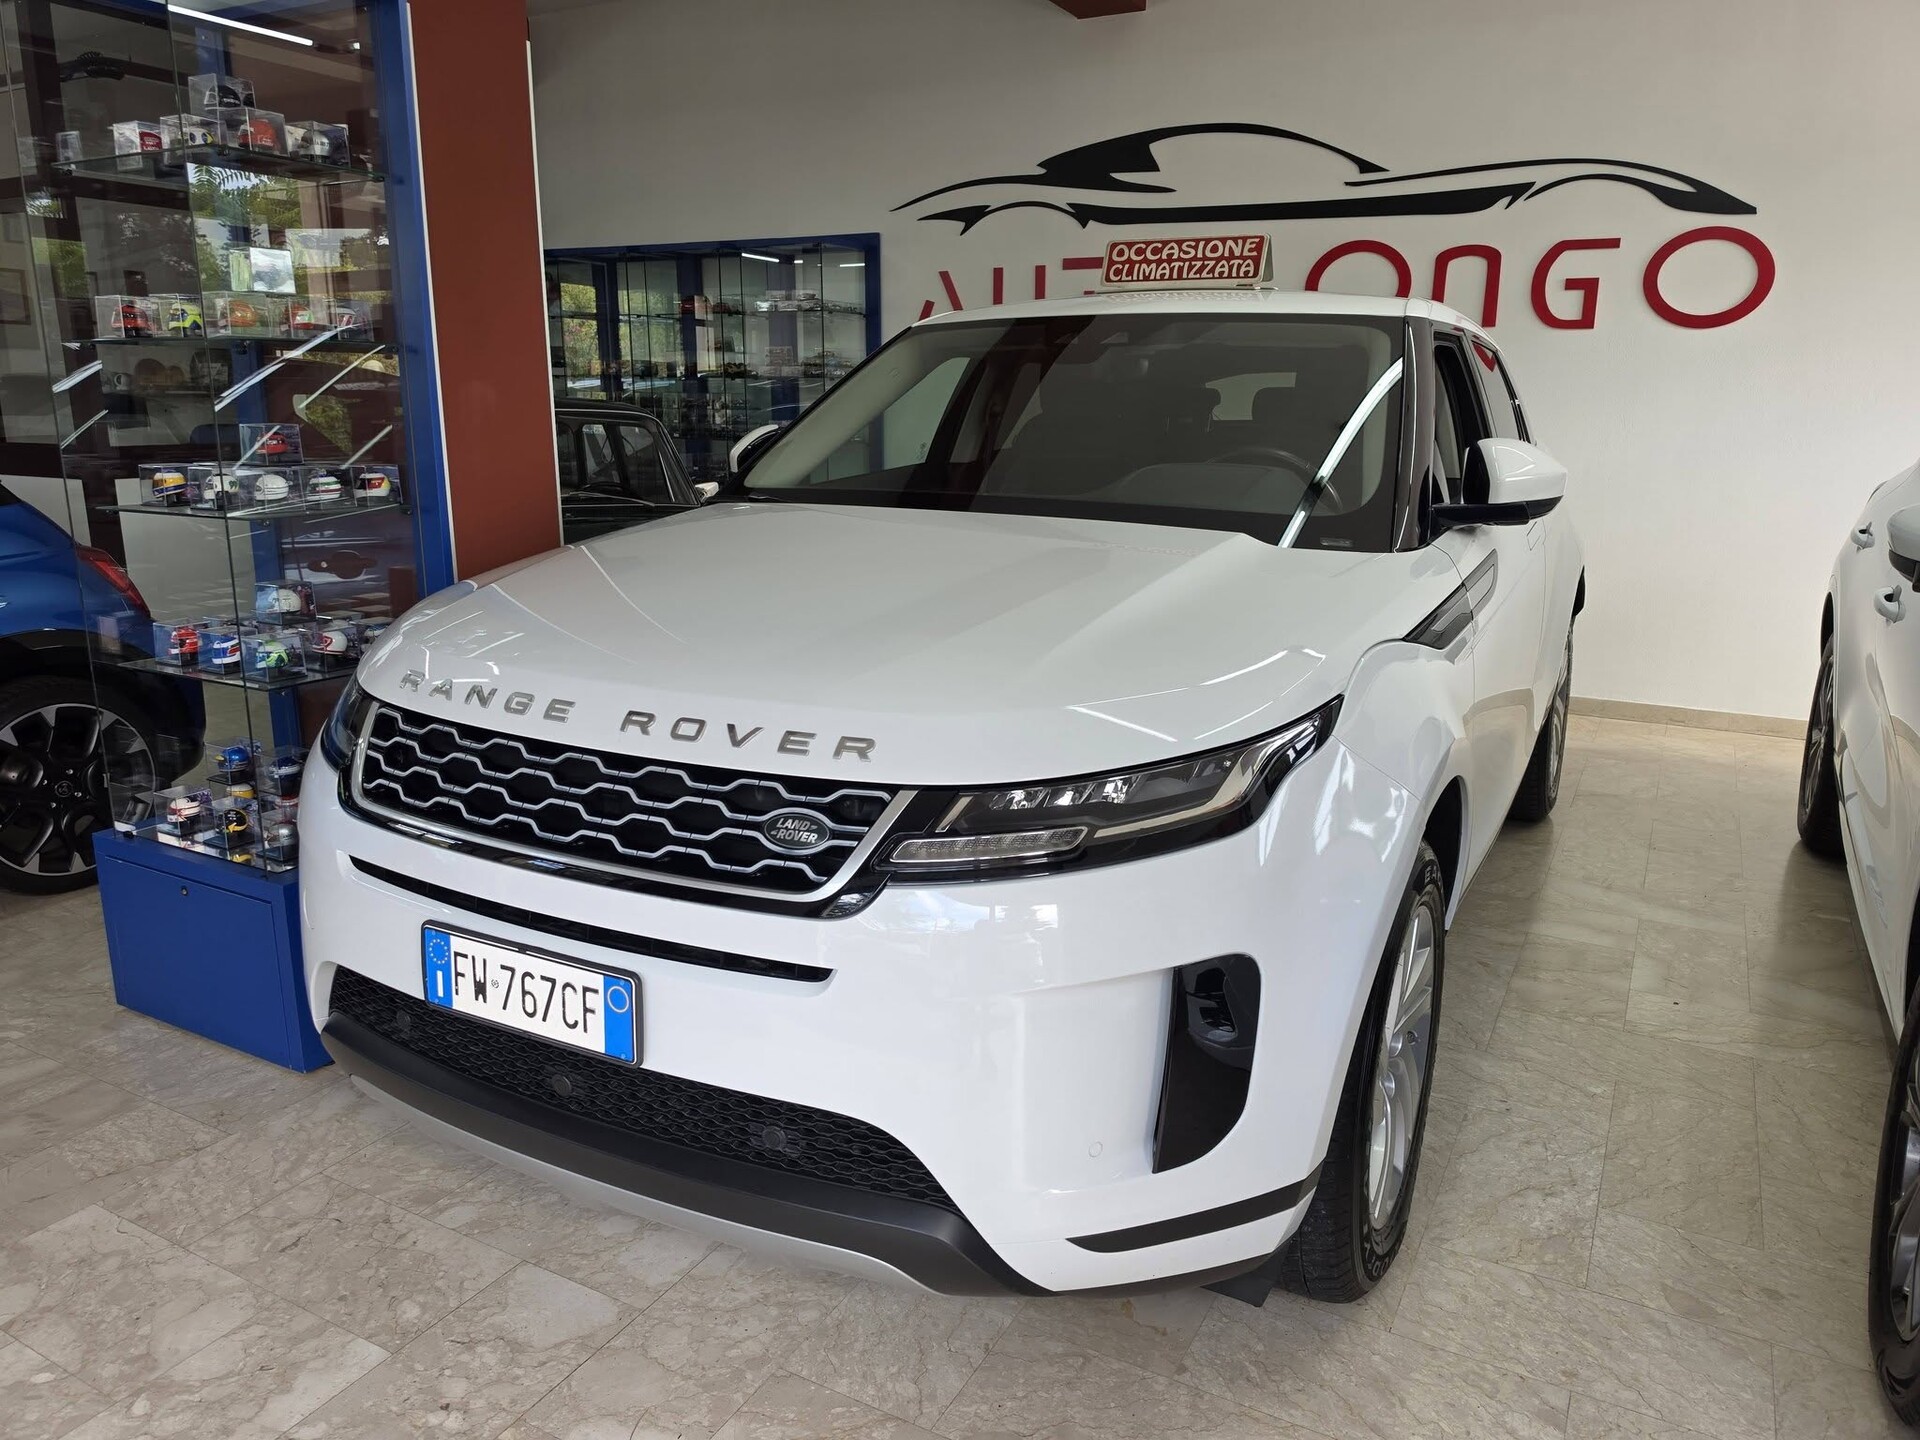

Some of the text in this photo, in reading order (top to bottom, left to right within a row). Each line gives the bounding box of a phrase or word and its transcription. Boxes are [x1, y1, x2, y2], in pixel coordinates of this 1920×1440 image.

[1111, 237, 1260, 262] OCCASIONE
[1109, 258, 1255, 282] CLIMATIZZATA
[399, 668, 877, 763] RANGE ROVER
[776, 817, 812, 831] LAND
[776, 828, 819, 844] ROVER
